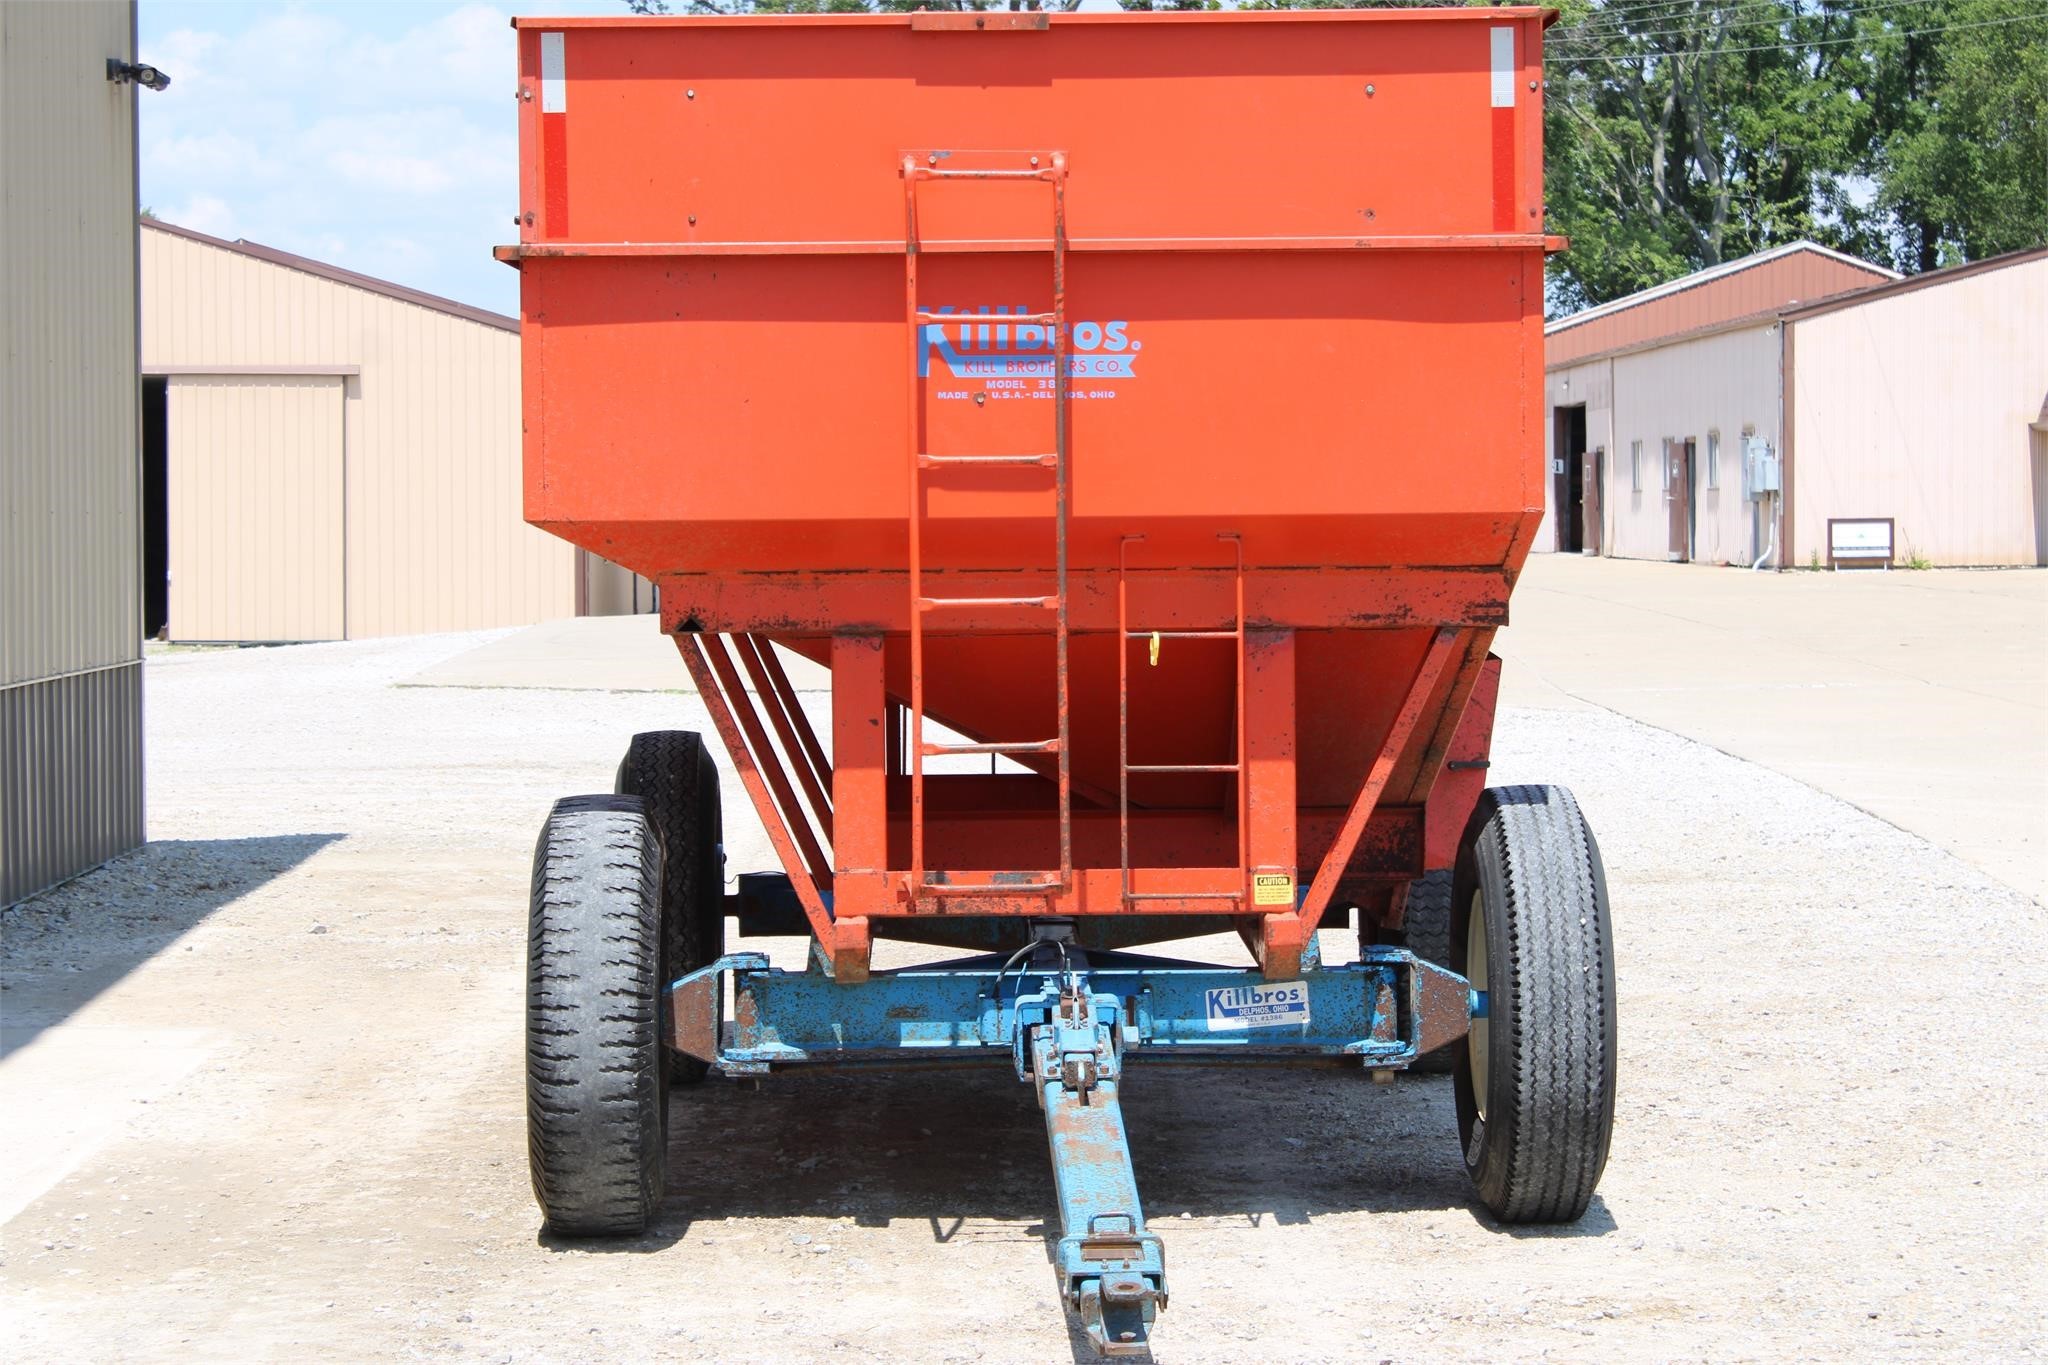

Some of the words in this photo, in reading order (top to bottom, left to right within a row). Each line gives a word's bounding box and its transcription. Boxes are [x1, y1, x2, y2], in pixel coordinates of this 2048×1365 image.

[964, 360, 996, 373] KILL
[1006, 360, 1087, 373] BROTHRS
[1095, 360, 1123, 373] CO.
[986, 380, 1026, 389] MODEL
[1038, 380, 1067, 389] 38
[937, 391, 969, 399] MADE
[1089, 391, 1116, 399] OHIO
[1259, 877, 1288, 885] CAUTION
[1207, 987, 1299, 1018] Killbros
[1273, 1004, 1289, 1013] OHIO
